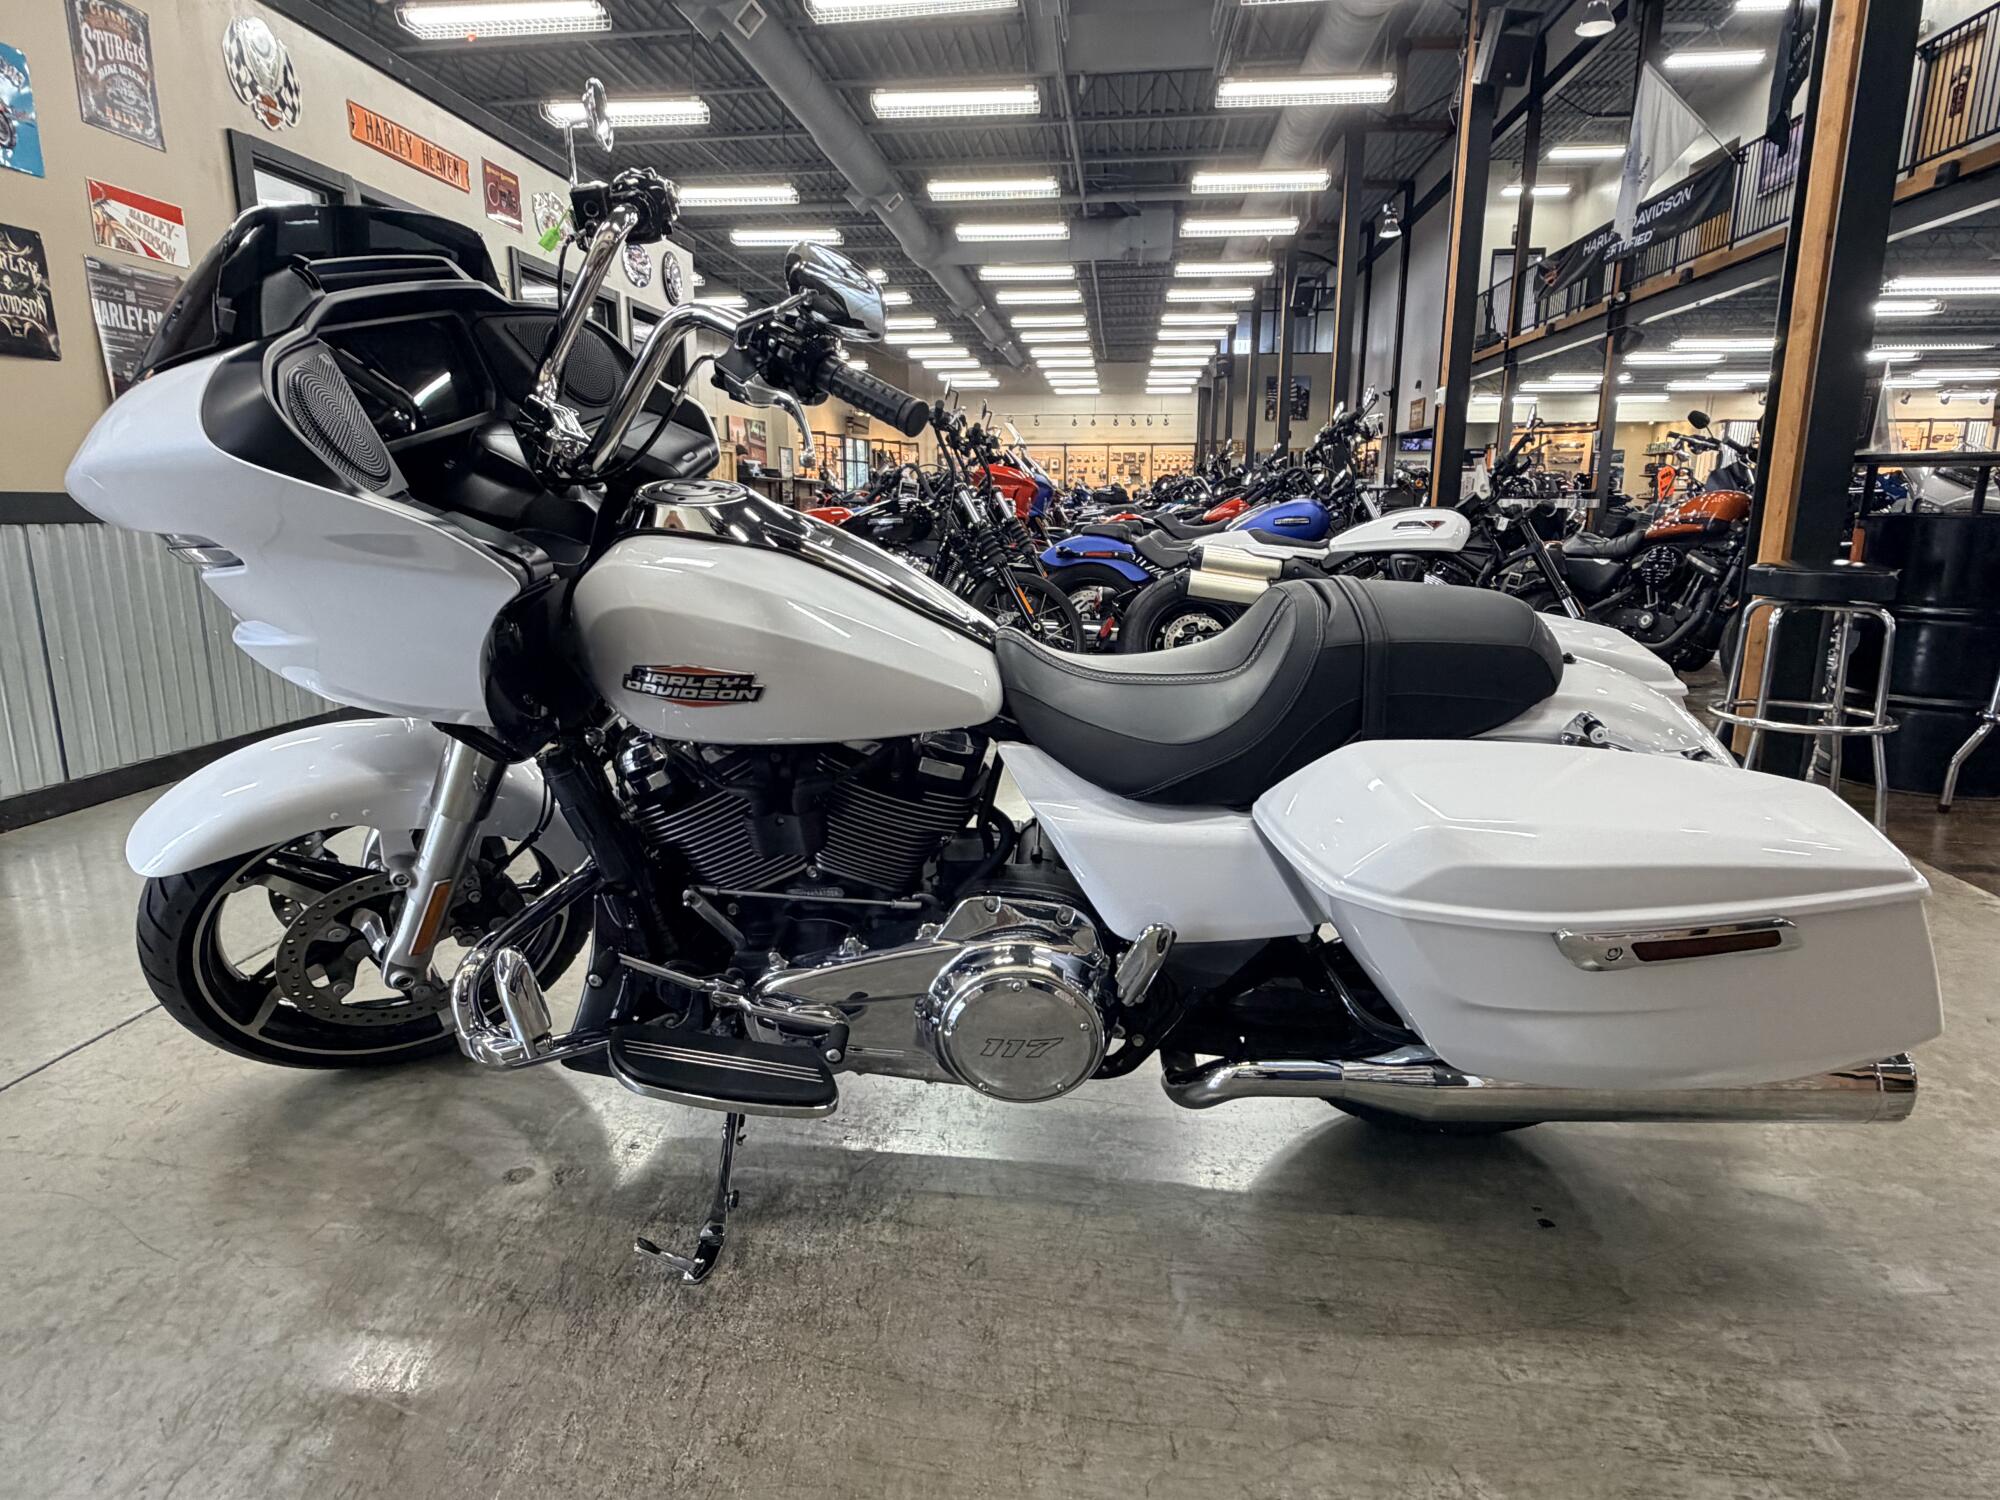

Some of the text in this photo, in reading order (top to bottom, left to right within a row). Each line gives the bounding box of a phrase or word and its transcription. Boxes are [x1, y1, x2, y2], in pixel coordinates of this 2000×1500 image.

[81, 22, 148, 75] STURGIS
[364, 111, 412, 160] HARLEY
[421, 142, 463, 186] HEAVEN
[125, 217, 176, 263] DAVIDSON
[128, 208, 180, 241] HARLEY-
[625, 680, 758, 700] DAVIDSON
[632, 669, 748, 688] HARLEY-
[980, 1037, 1064, 1058] 117
